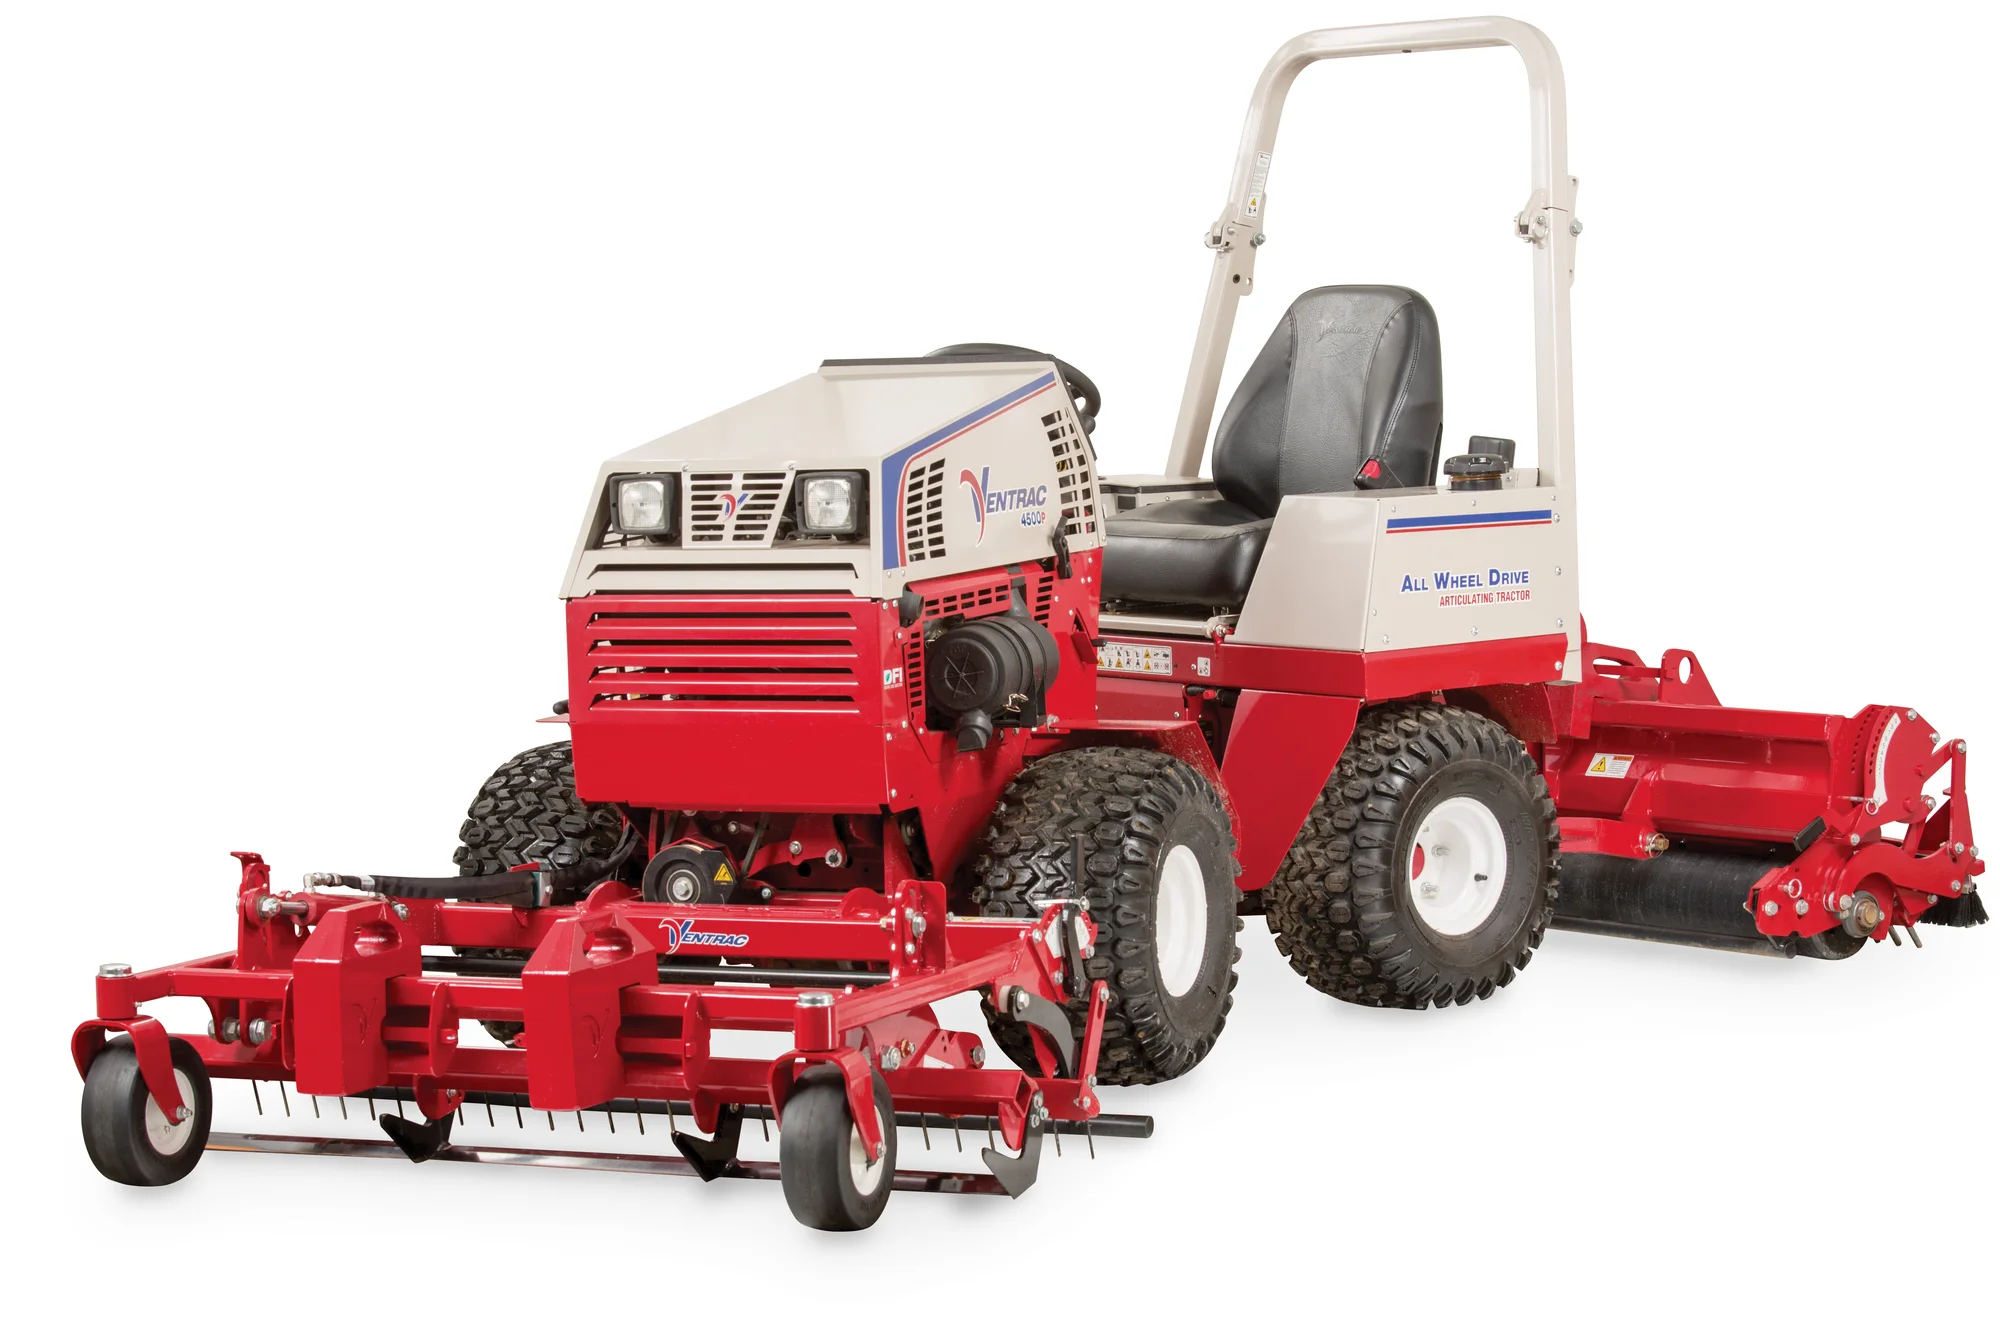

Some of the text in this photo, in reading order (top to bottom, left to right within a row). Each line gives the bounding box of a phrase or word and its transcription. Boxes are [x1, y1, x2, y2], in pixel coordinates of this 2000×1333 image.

[959, 465, 1047, 548] VENTRAC
[1021, 511, 1046, 526] 4500P
[1401, 568, 1529, 592] ALL WHEEL DRIVE
[1439, 590, 1530, 607] ARTICULATING TRACTOR
[883, 667, 902, 685] DFI
[658, 918, 749, 954] VENTRAC
